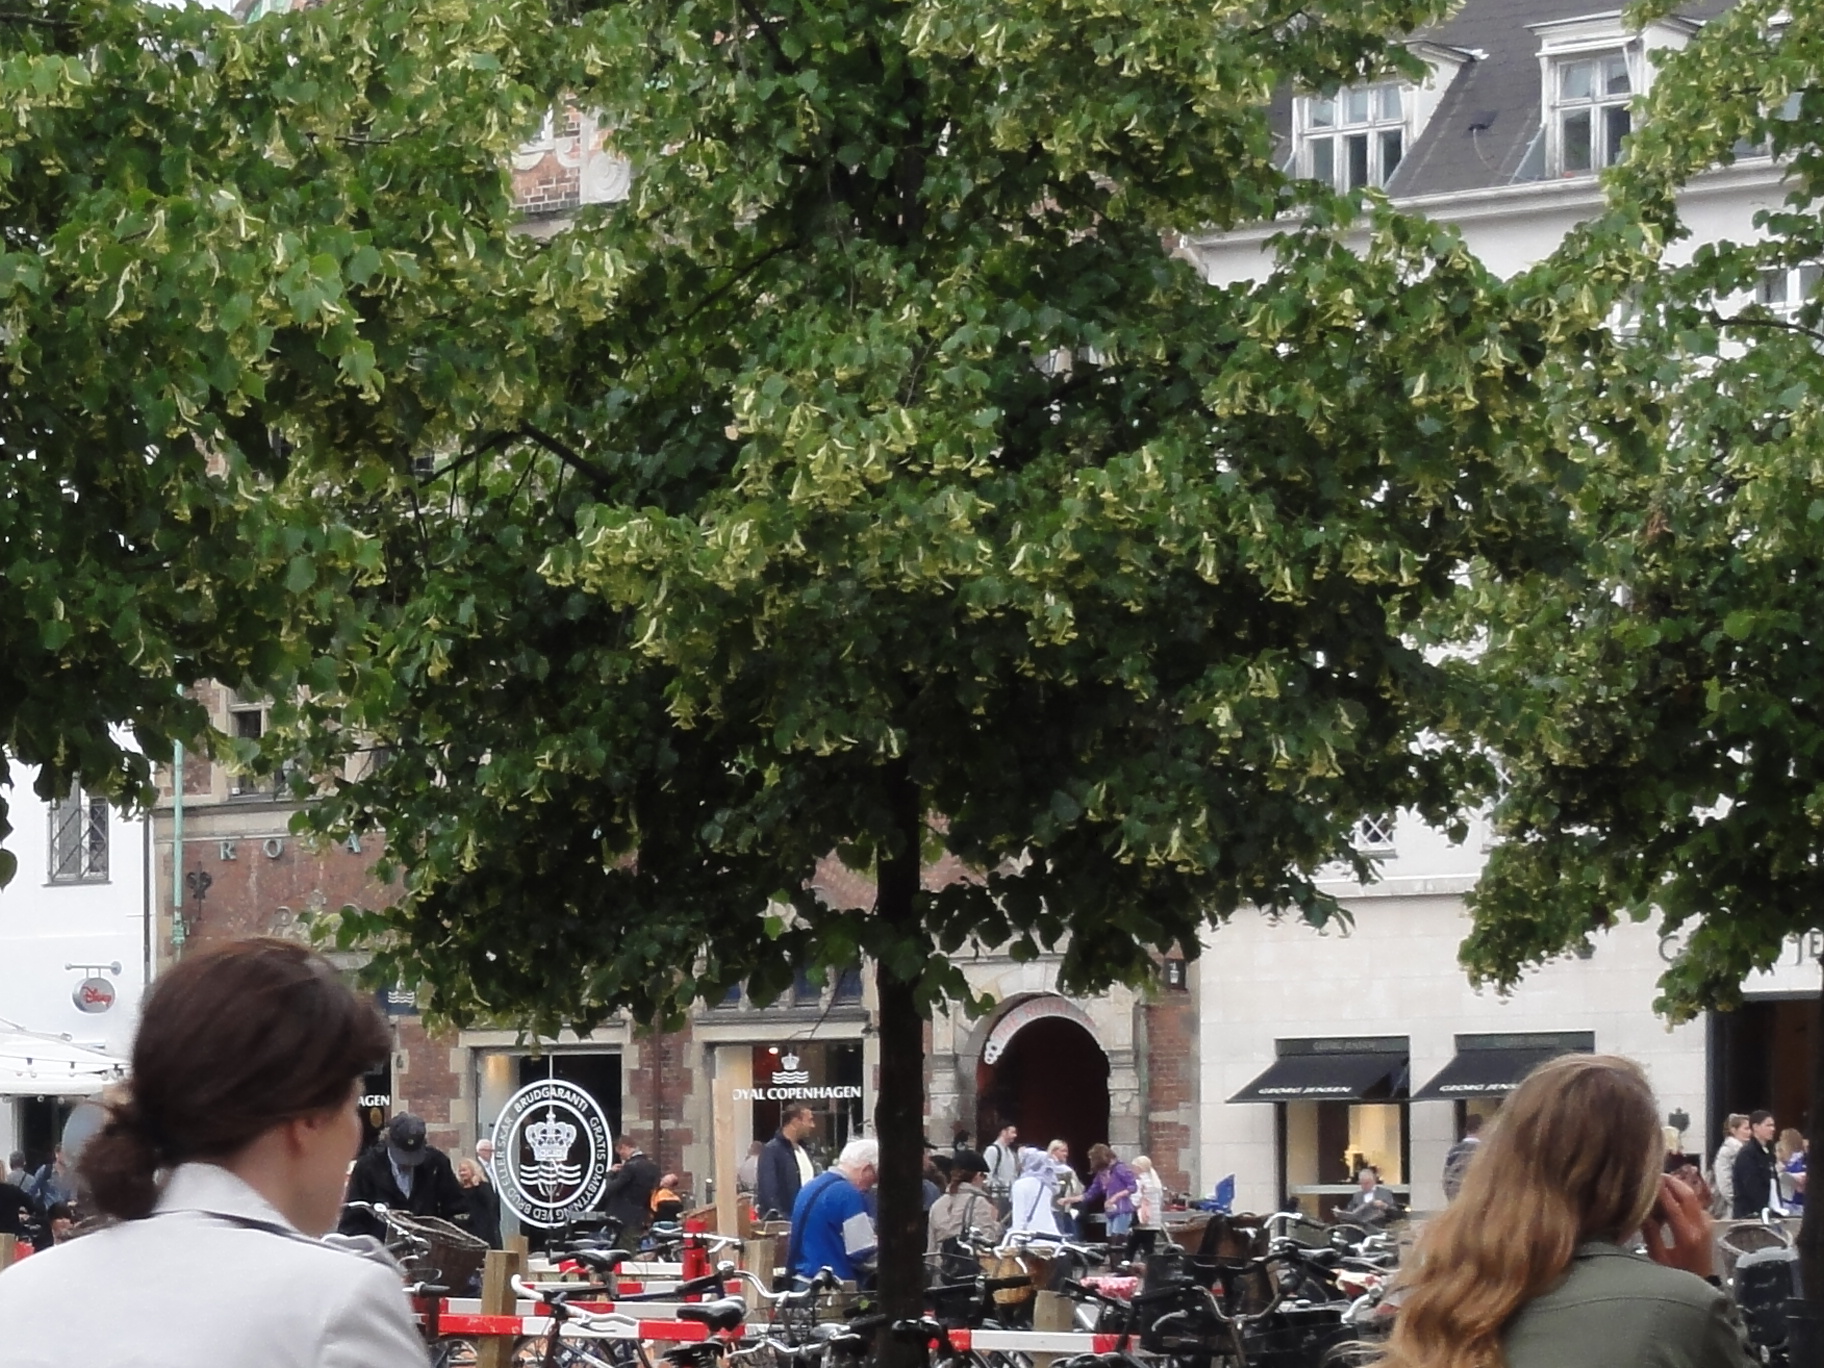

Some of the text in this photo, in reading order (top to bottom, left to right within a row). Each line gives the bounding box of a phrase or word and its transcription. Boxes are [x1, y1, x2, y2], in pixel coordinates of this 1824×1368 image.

[732, 1086, 862, 1101] OYAL COPENHAGEN
[1258, 1086, 1352, 1095] GEORG JENSEN
[1439, 1083, 1520, 1092] GEORG JENS
[514, 1087, 589, 1113] BRUDGARANTI
[589, 1116, 606, 1161] GRATIS
[496, 1151, 512, 1187] ELLER
[507, 1187, 531, 1214] BRUD
[533, 1208, 554, 1221] VED
